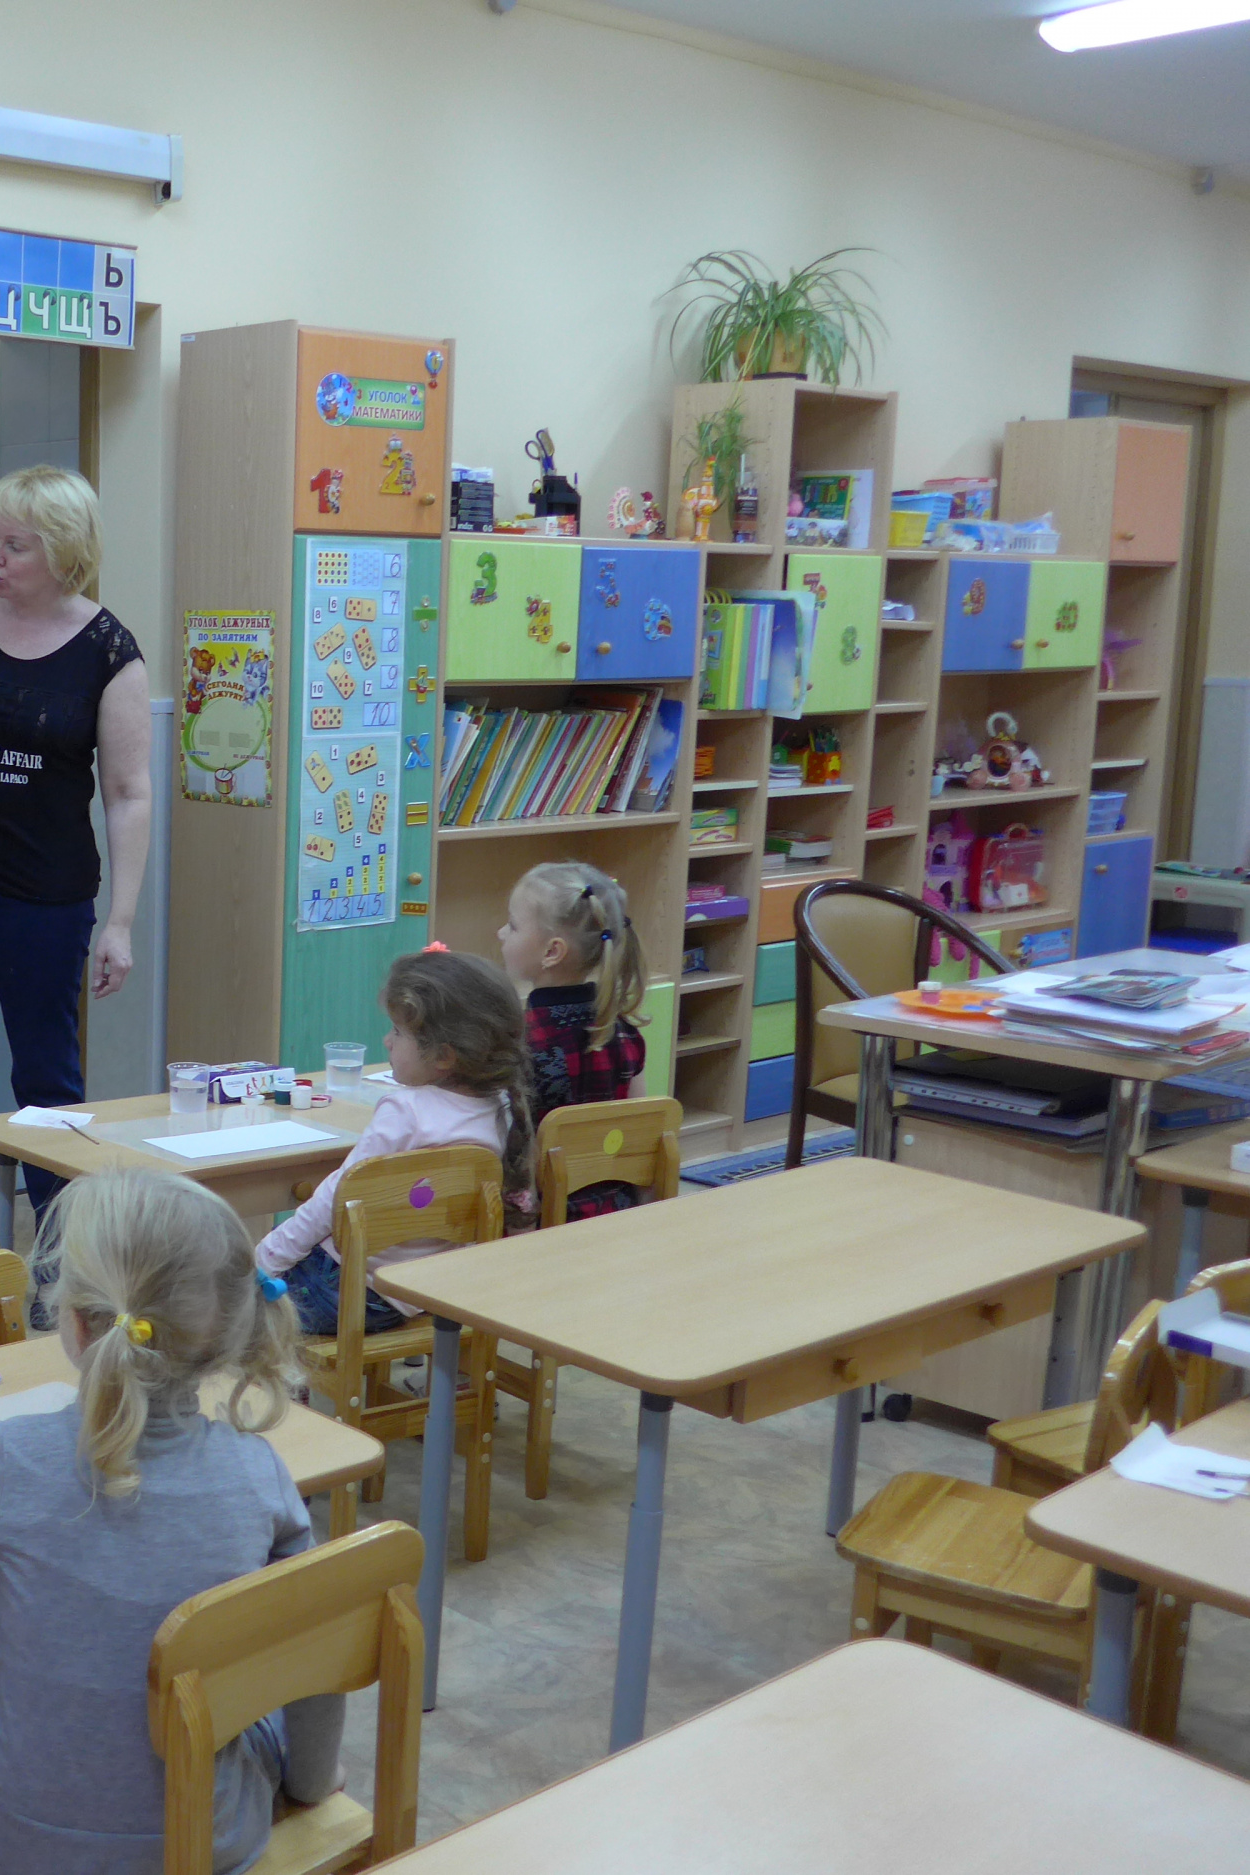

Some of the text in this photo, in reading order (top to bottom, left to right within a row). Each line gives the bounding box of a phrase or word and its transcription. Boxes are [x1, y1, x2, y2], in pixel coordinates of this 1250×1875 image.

[368, 390, 407, 404] УГОЛОК
[352, 406, 422, 420] МАТЕМАТИКИ
[380, 450, 404, 494] 2
[310, 468, 332, 514] 1
[390, 553, 401, 578] 6
[332, 600, 336, 608] 6
[315, 610, 321, 619] 8
[189, 618, 270, 628] УГОЛОК ДЕЖУРНЫХ
[198, 633, 208, 641] ПО
[388, 628, 398, 652] 8
[346, 651, 351, 660] 9
[386, 665, 398, 689] 9
[207, 681, 244, 692] СЕГОДНЯ
[313, 684, 323, 693] 10
[366, 684, 371, 692] 7
[370, 702, 390, 726] 10
[0, 750, 43, 769] AFFAIR
[0, 772, 10, 783] LA
[10, 774, 28, 784] PACO
[359, 791, 364, 799] 4
[317, 812, 323, 820] 2
[322, 898, 333, 922] 2
[339, 896, 349, 919] 3
[357, 896, 366, 917] 4
[372, 894, 381, 915] 5
